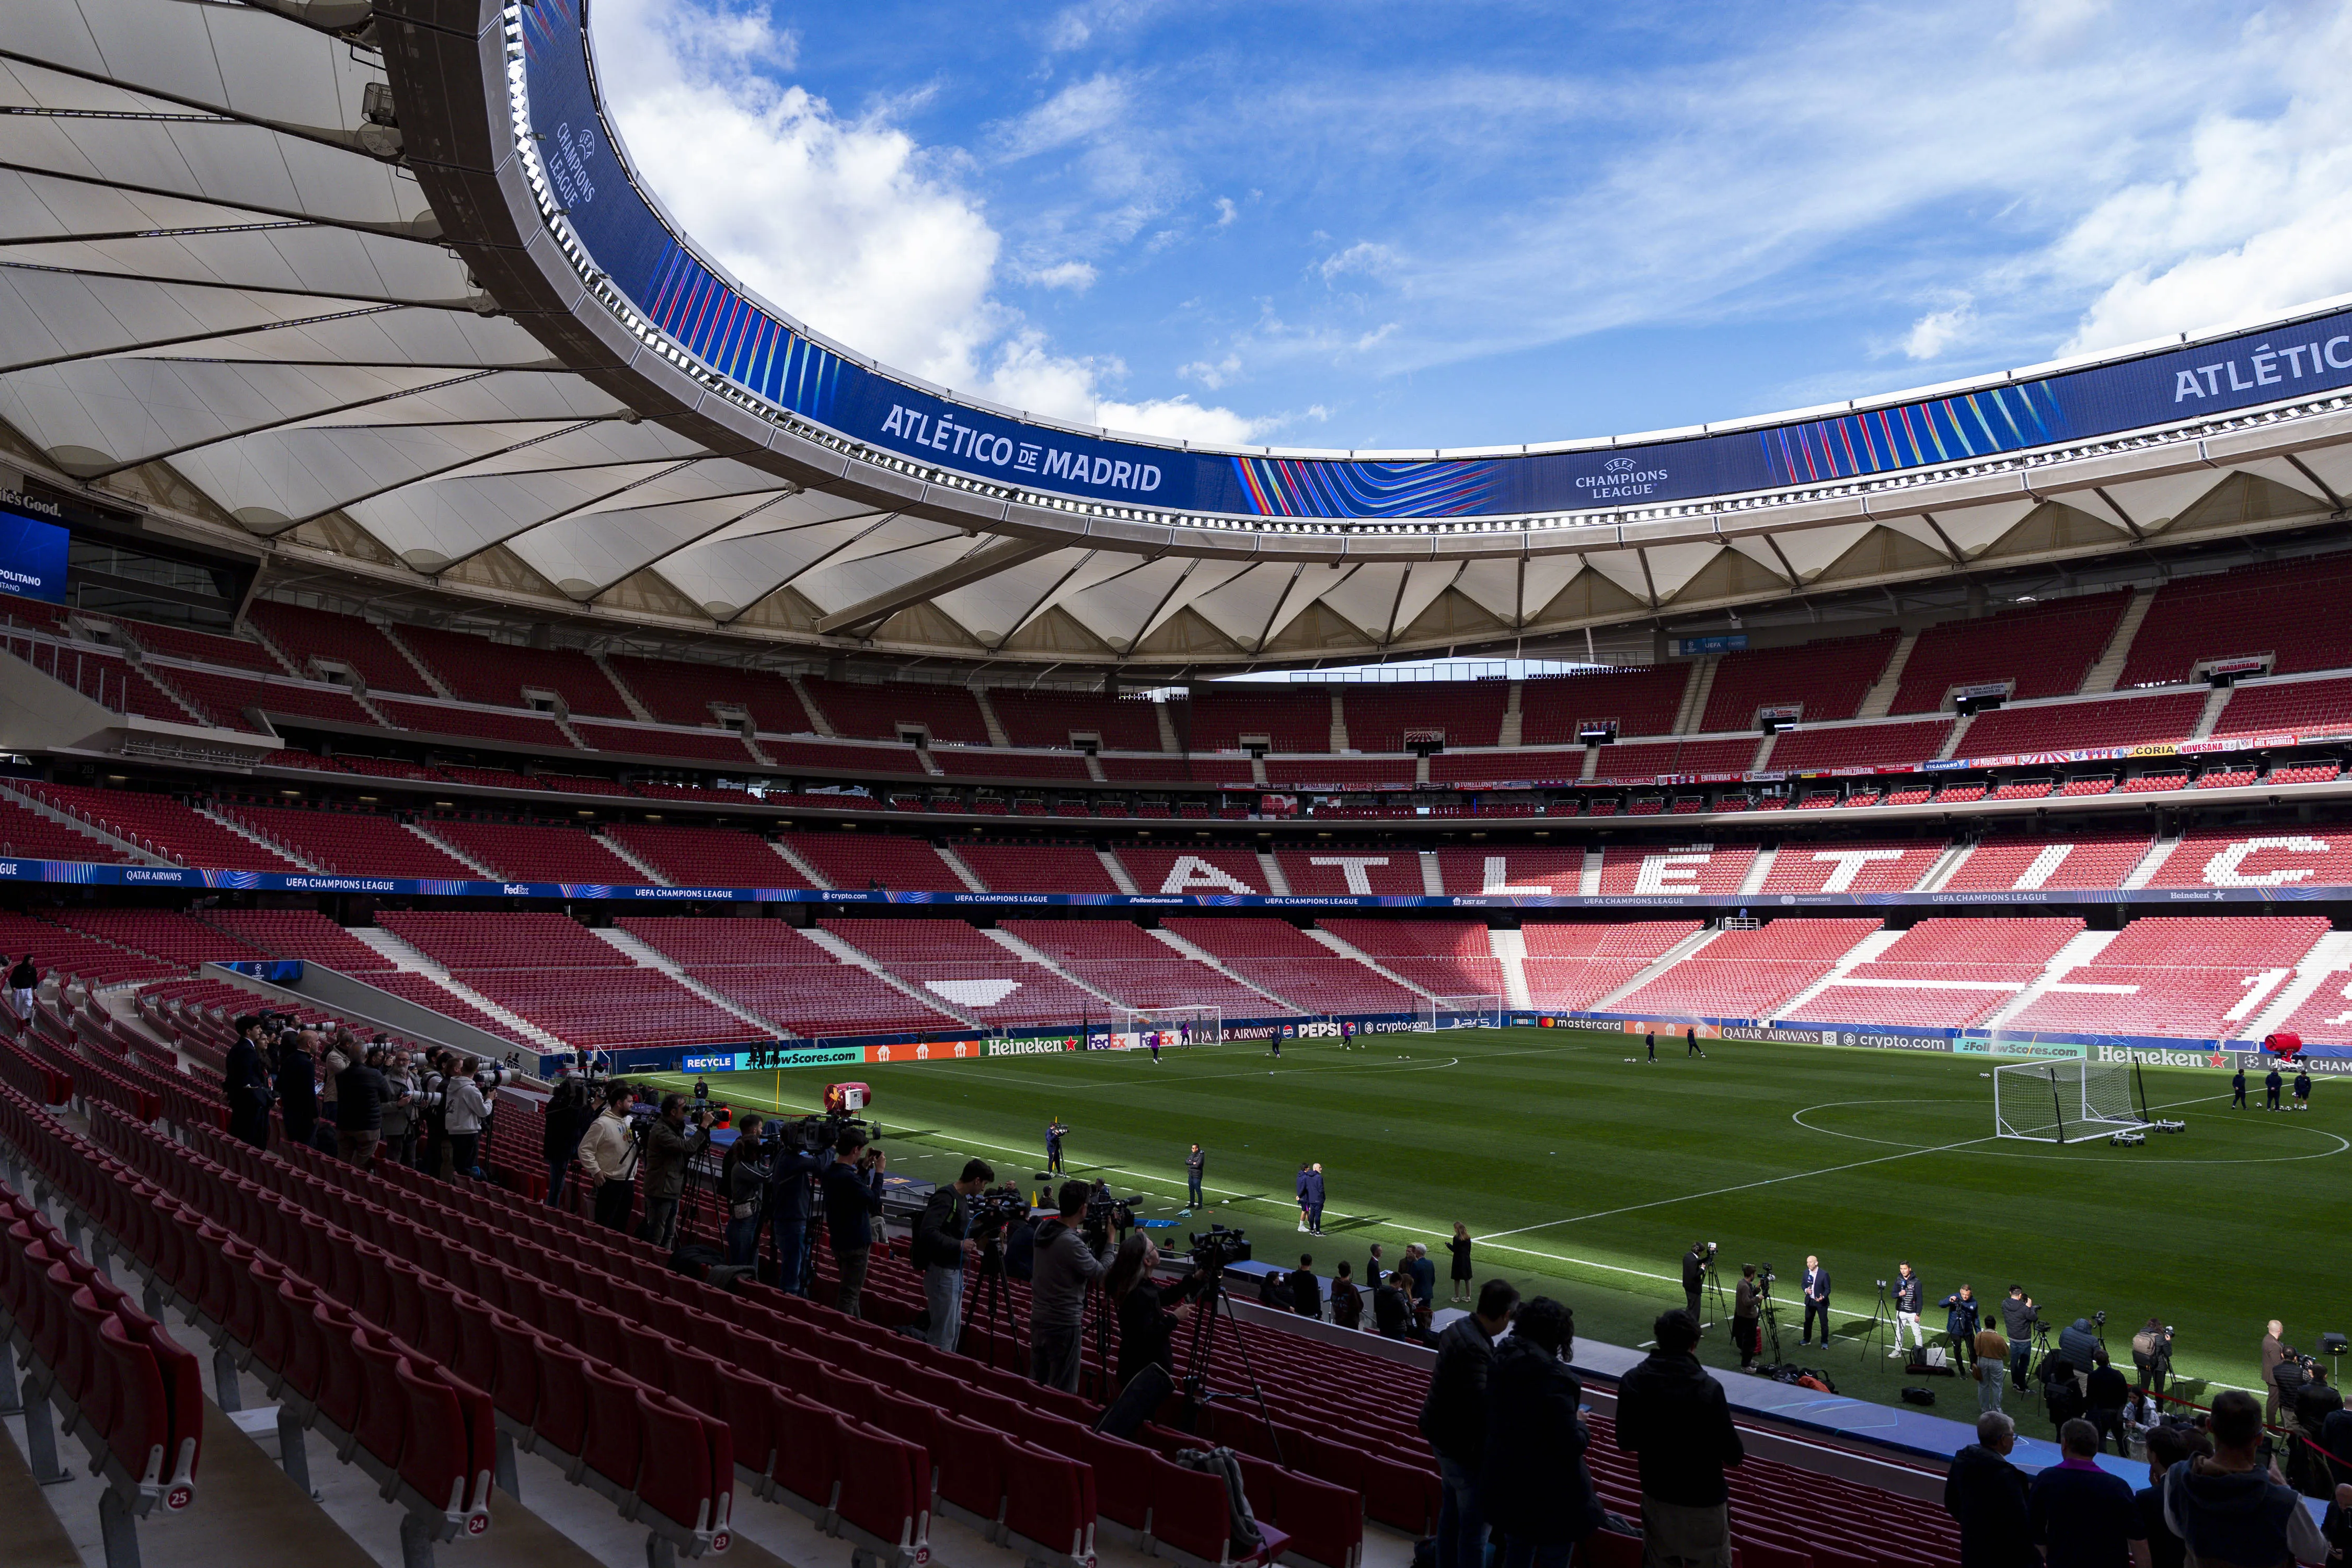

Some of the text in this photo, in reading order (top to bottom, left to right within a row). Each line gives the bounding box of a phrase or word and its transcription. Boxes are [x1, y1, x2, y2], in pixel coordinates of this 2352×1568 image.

[579, 131, 594, 158] UEFA
[557, 122, 595, 202] CHAMPIONS
[549, 152, 578, 208] LEAGUE
[2175, 335, 2352, 403] ATLÉTIC
[881, 405, 1161, 491] ATLÉTICO DE MADRID
[1606, 460, 1634, 471] UEFA
[1576, 469, 1668, 488] CHAMPIONS
[1593, 484, 1653, 499] LEAGUE
[23, 496, 62, 517] Good.
[2182, 743, 2223, 753] NOVESANA
[2266, 738, 2295, 746] PARDILLO
[2136, 746, 2174, 754] CORIA
[1980, 756, 2016, 766] MIGUELTURRA
[82, 764, 95, 774] 213
[1831, 767, 1874, 776] MORALZARZAL
[126, 871, 181, 881] QATAR AIRWAYS
[286, 878, 394, 890] UEFA CHAMPIONS LEAGUE
[504, 884, 528, 894] FedEx
[1298, 1023, 1341, 1038] PEPSI
[1376, 1021, 1428, 1035] crypto.com
[1557, 1019, 1621, 1030] mastercard
[1139, 1031, 1174, 1046] FeEx
[1723, 1027, 1818, 1043] QATAR AIRWAYS
[1860, 1034, 1945, 1049] crypto.com
[988, 1037, 1063, 1056] Heineken
[1089, 1034, 1126, 1050] FedEx
[687, 1057, 731, 1068] RECYCLE
[2097, 1045, 2204, 1067] Heineken
[171, 1492, 187, 1505] 25
[471, 1519, 484, 1530] 24
[716, 1536, 727, 1548] 23
[918, 1551, 927, 1561] 22
